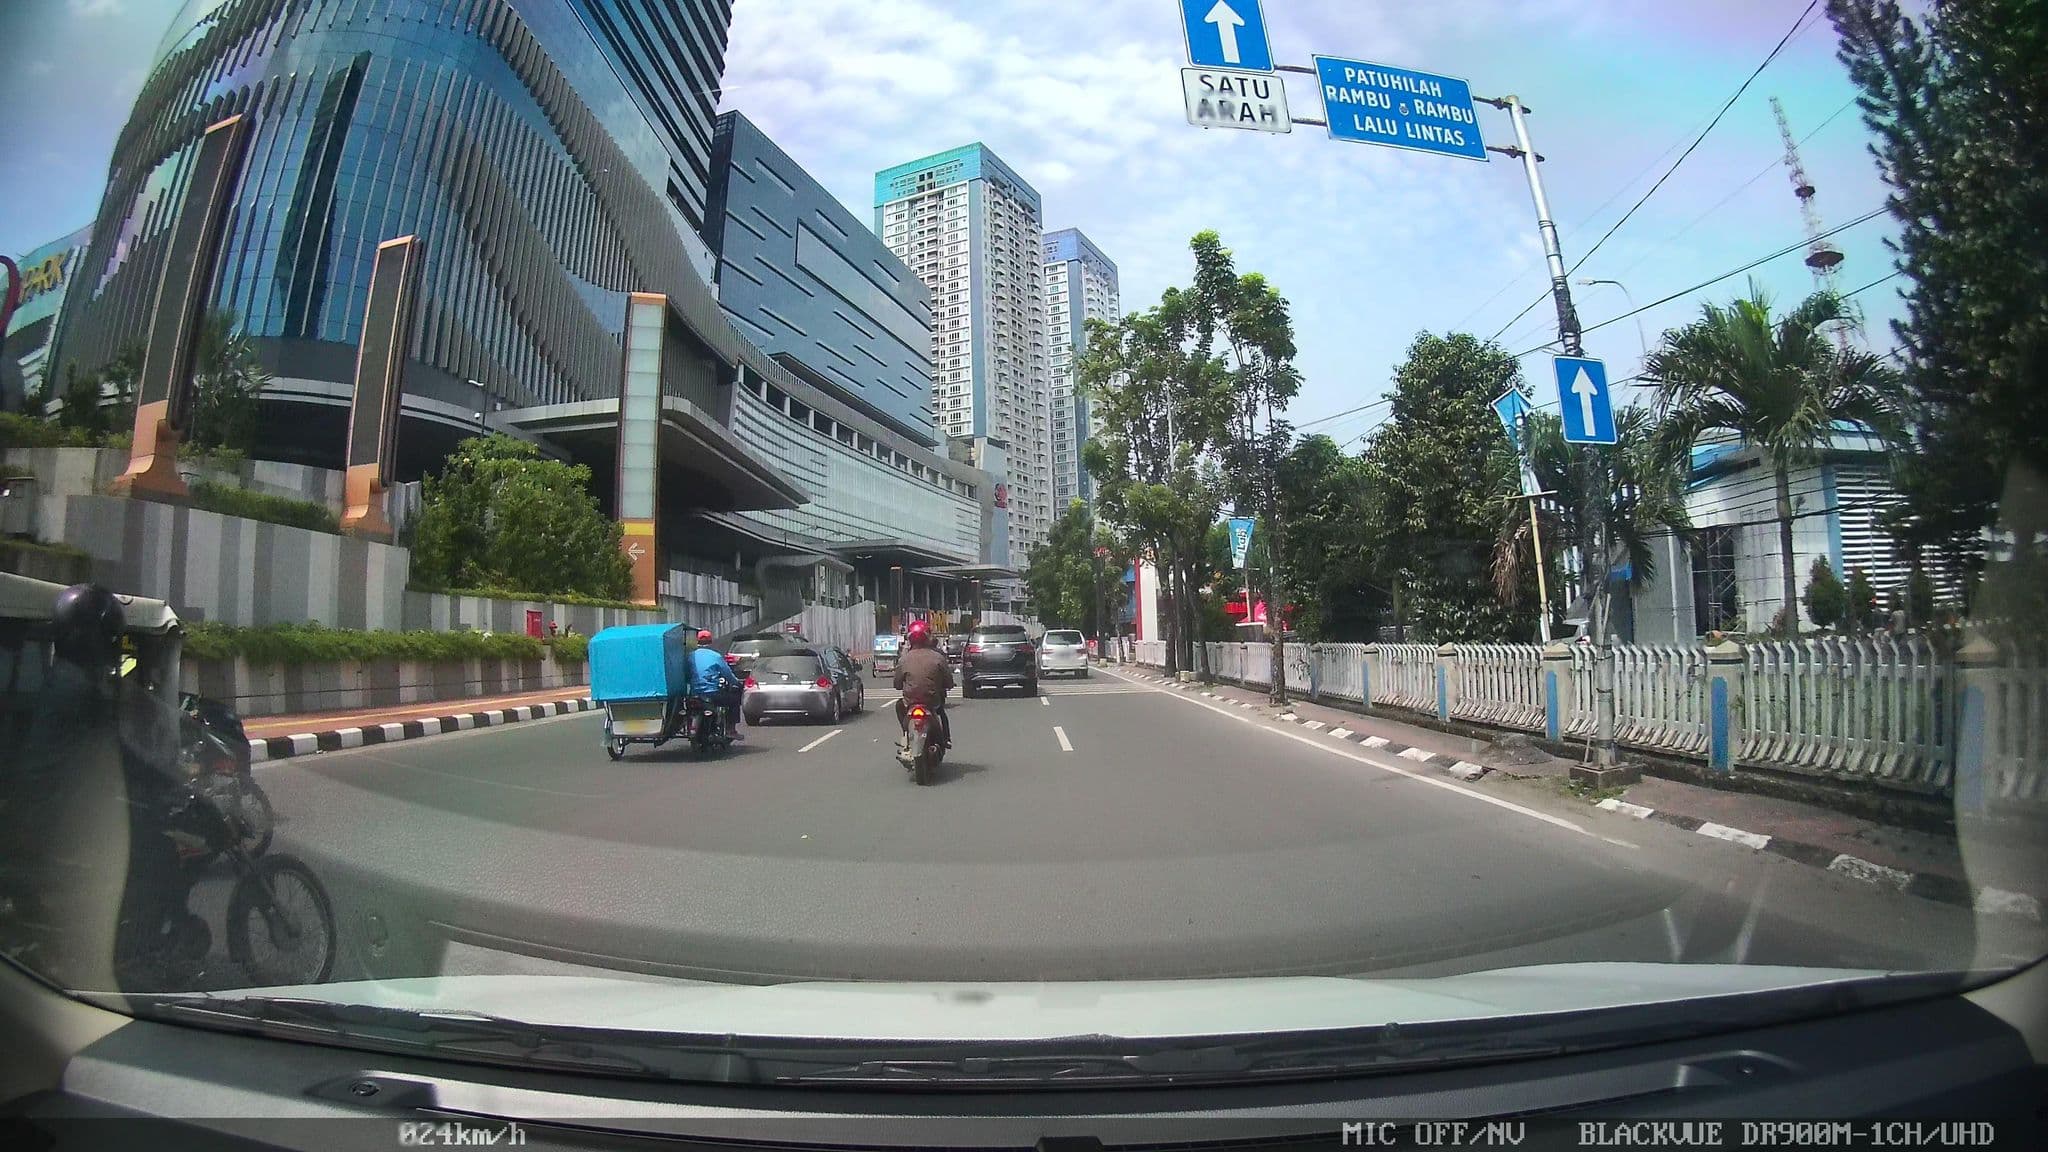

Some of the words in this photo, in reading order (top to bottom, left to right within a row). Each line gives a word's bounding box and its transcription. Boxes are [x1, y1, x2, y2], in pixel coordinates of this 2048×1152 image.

[1199, 74, 1270, 99] SATU
[1344, 67, 1442, 98] PATUHILAH
[1198, 98, 1277, 123] ARAH
[1325, 85, 1391, 109] RAMBU
[1414, 99, 1474, 124] RAMBU
[1353, 114, 1398, 136] LALU
[1405, 122, 1465, 147] LINTAS
